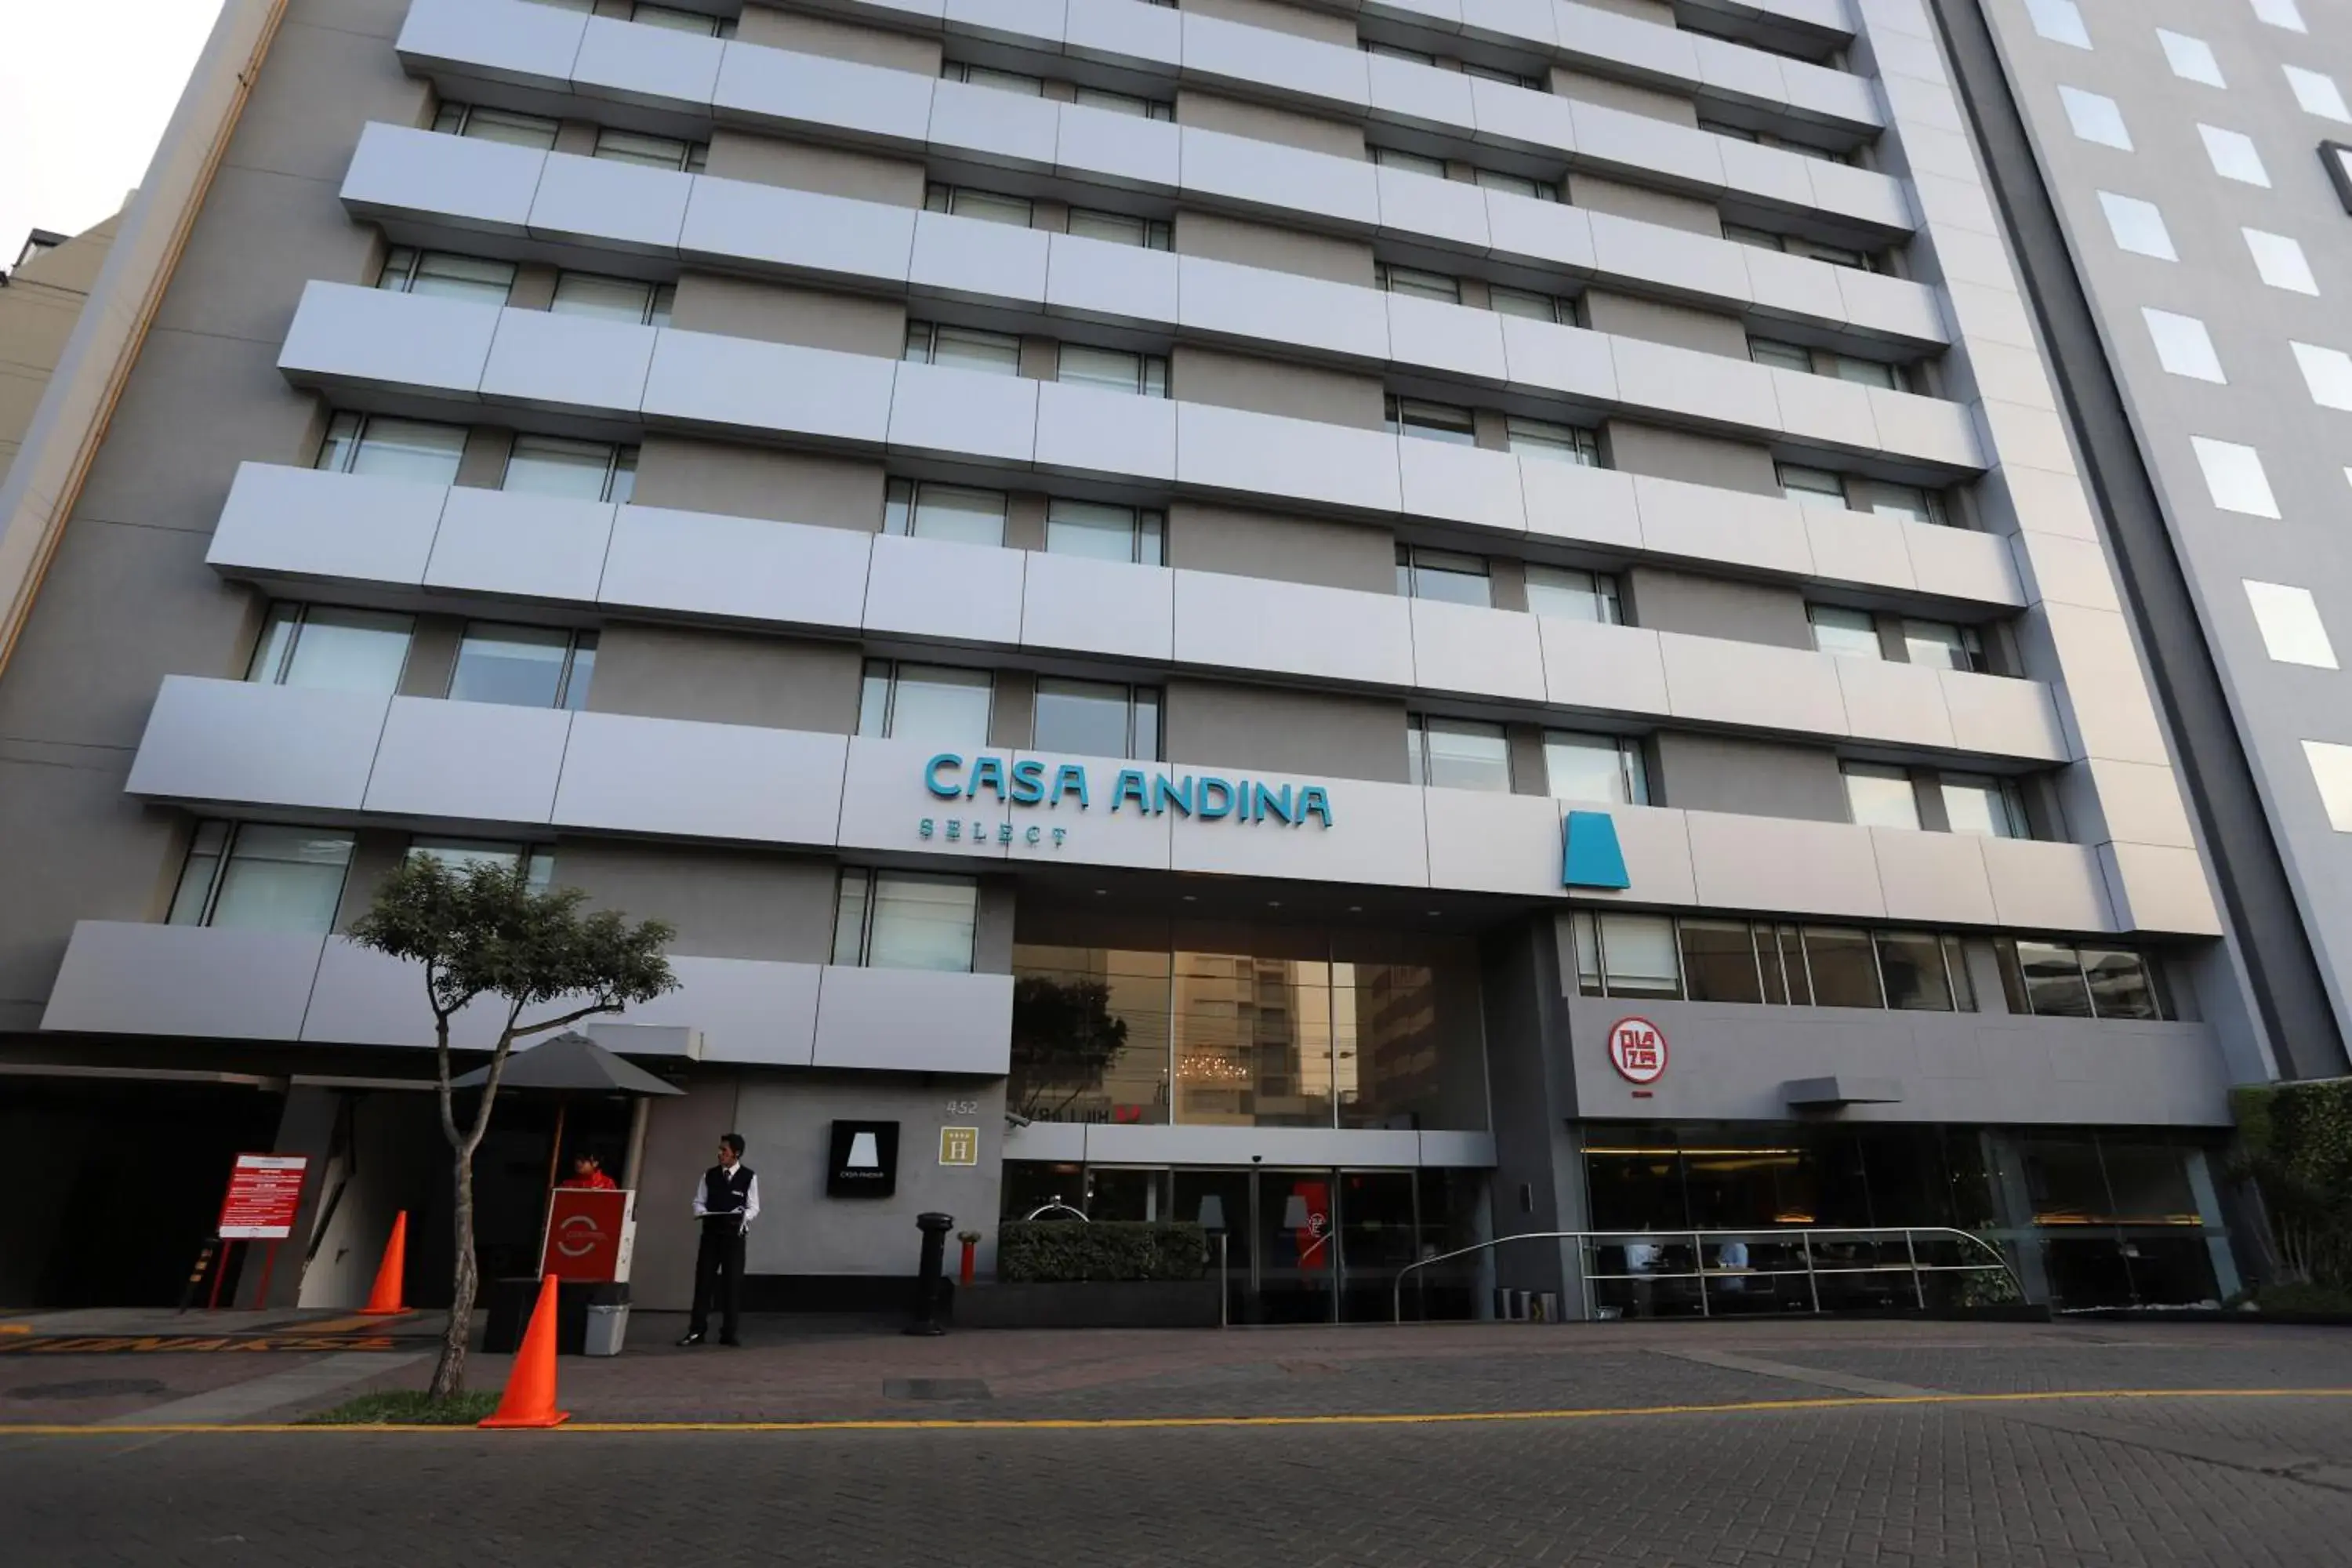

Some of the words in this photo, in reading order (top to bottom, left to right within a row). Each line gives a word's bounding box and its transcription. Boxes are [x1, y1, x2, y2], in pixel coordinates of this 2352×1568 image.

[925, 753, 1089, 808] CASA
[1112, 769, 1333, 827] ANDINA
[919, 818, 1067, 846] SELECT
[946, 1101, 978, 1114] 452
[949, 1141, 968, 1160] H
